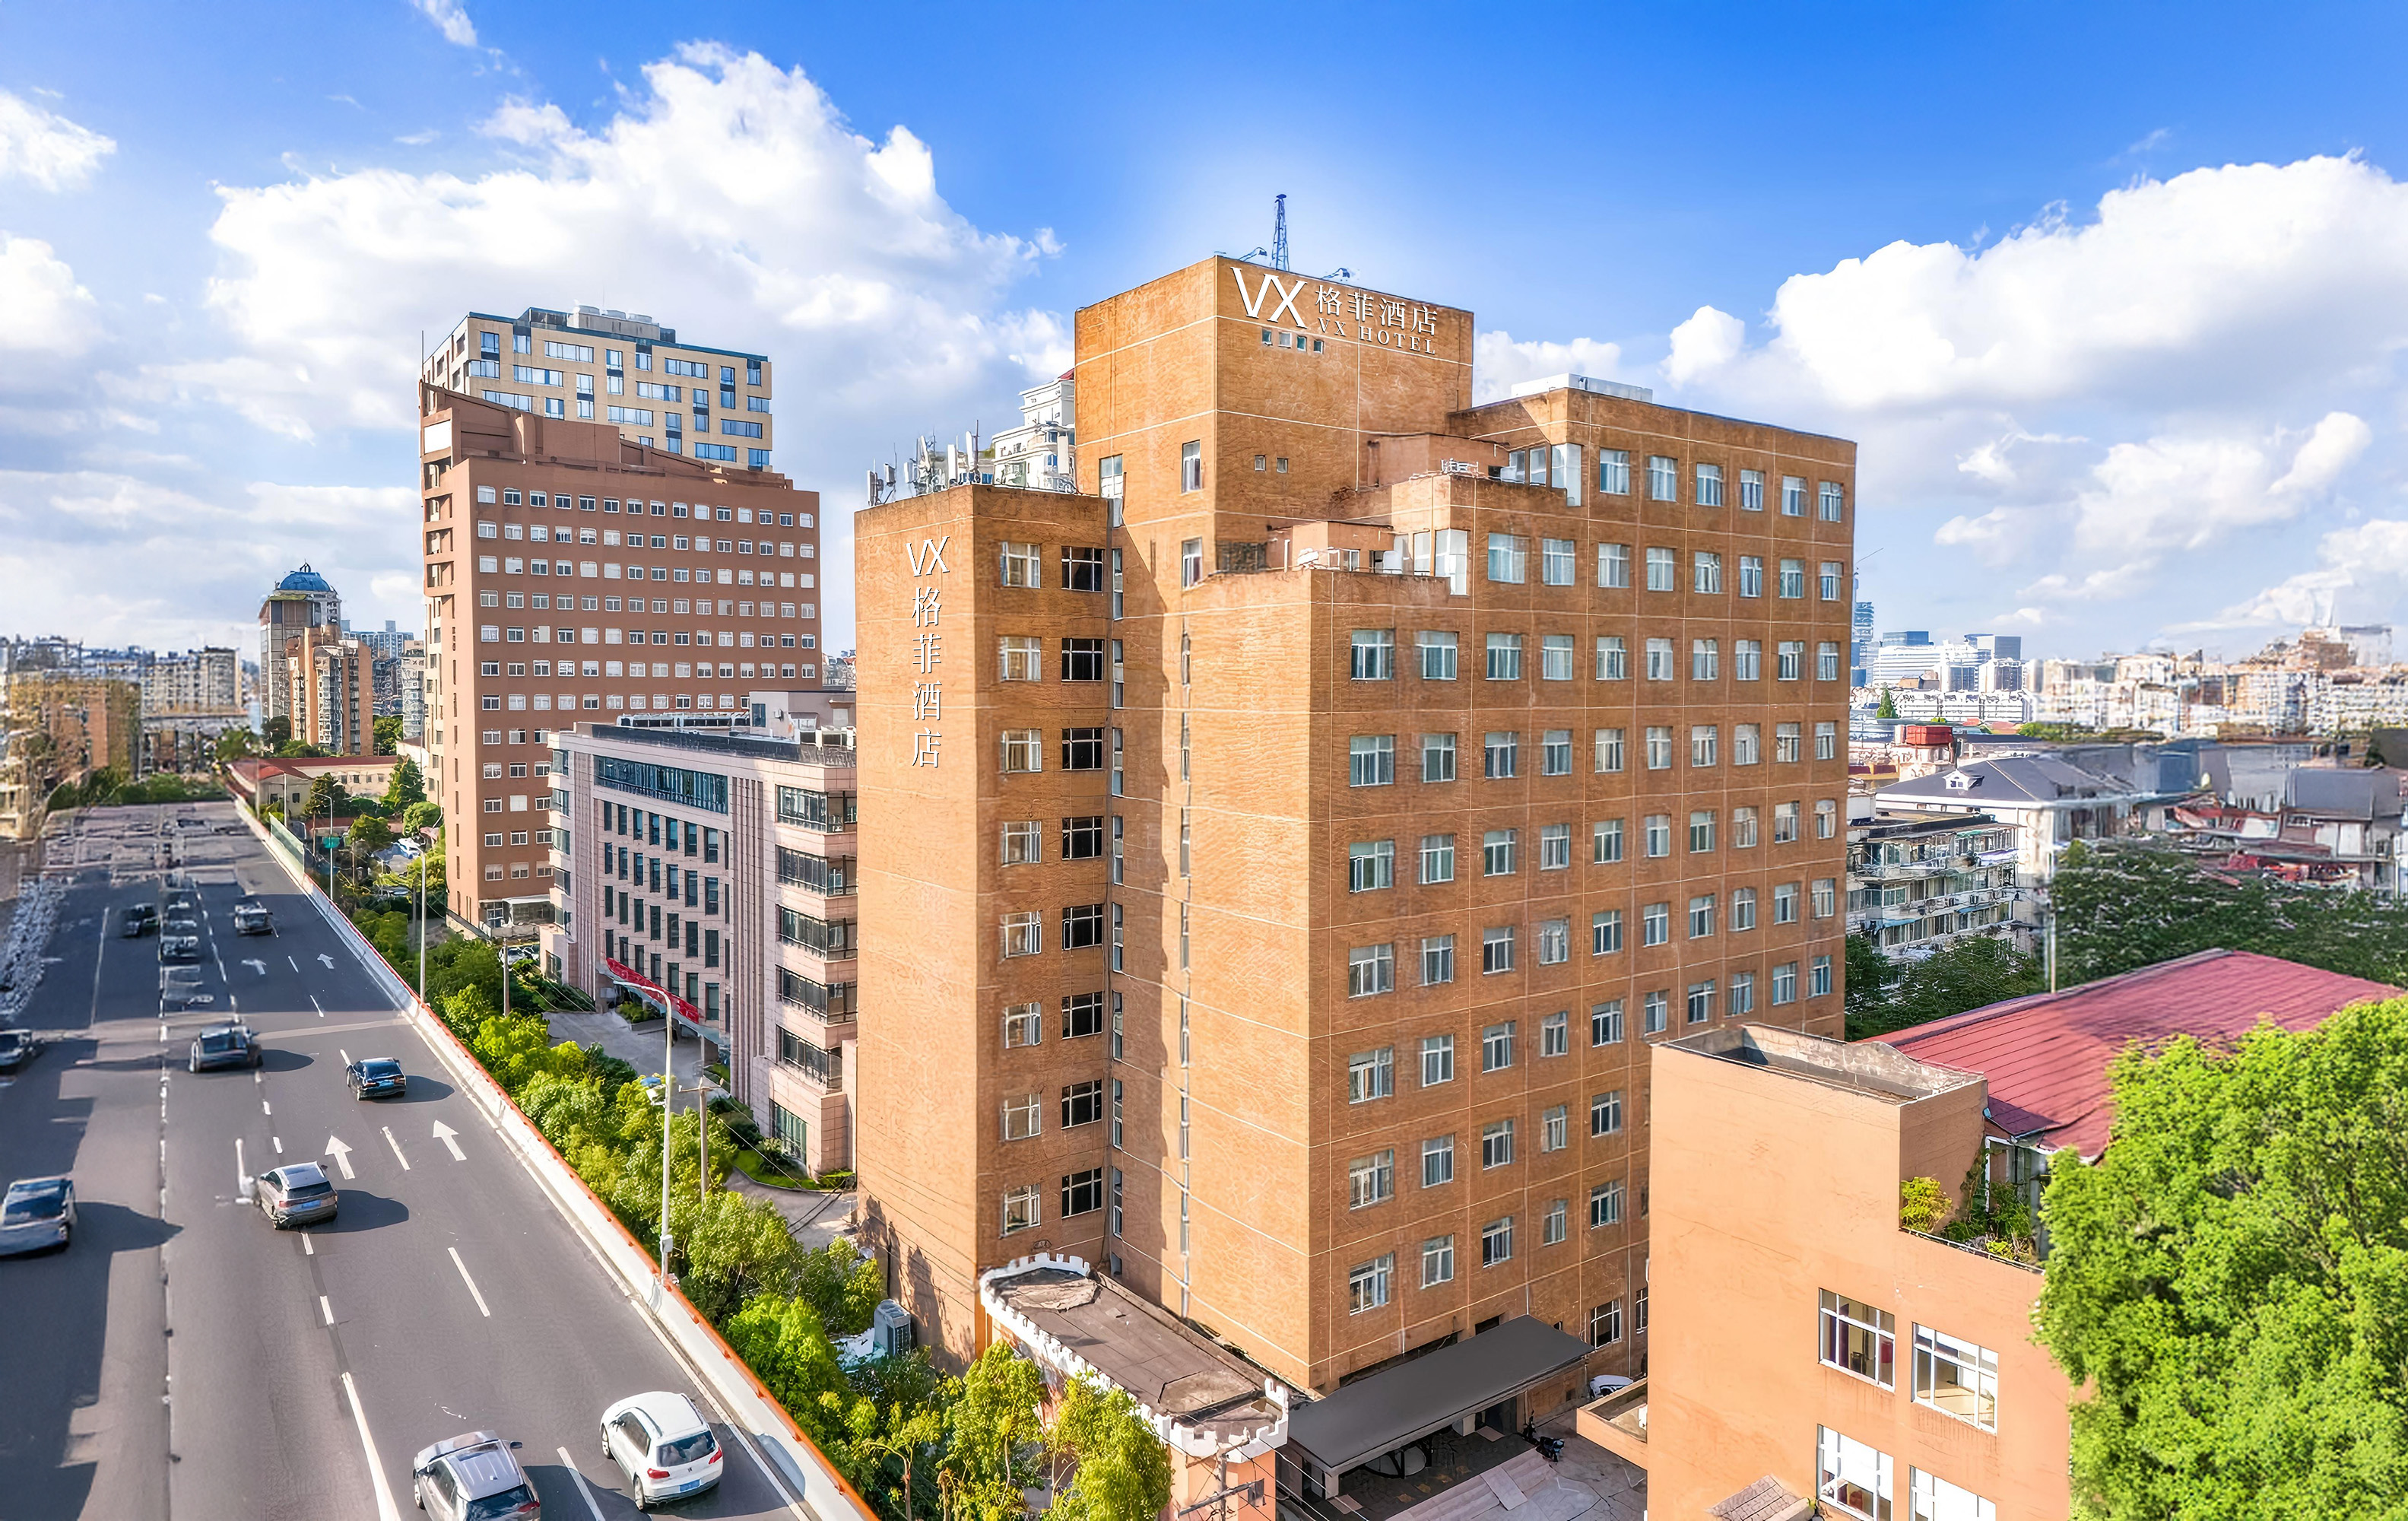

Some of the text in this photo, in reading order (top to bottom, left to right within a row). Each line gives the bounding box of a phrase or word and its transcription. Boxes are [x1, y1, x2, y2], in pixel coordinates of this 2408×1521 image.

[1230, 267, 1308, 329] VX
[1315, 284, 1438, 335] 格菲酒店
[1318, 317, 1436, 355] VX HOTEL
[905, 535, 950, 576] VX
[911, 586, 942, 768] 格菲酒店
